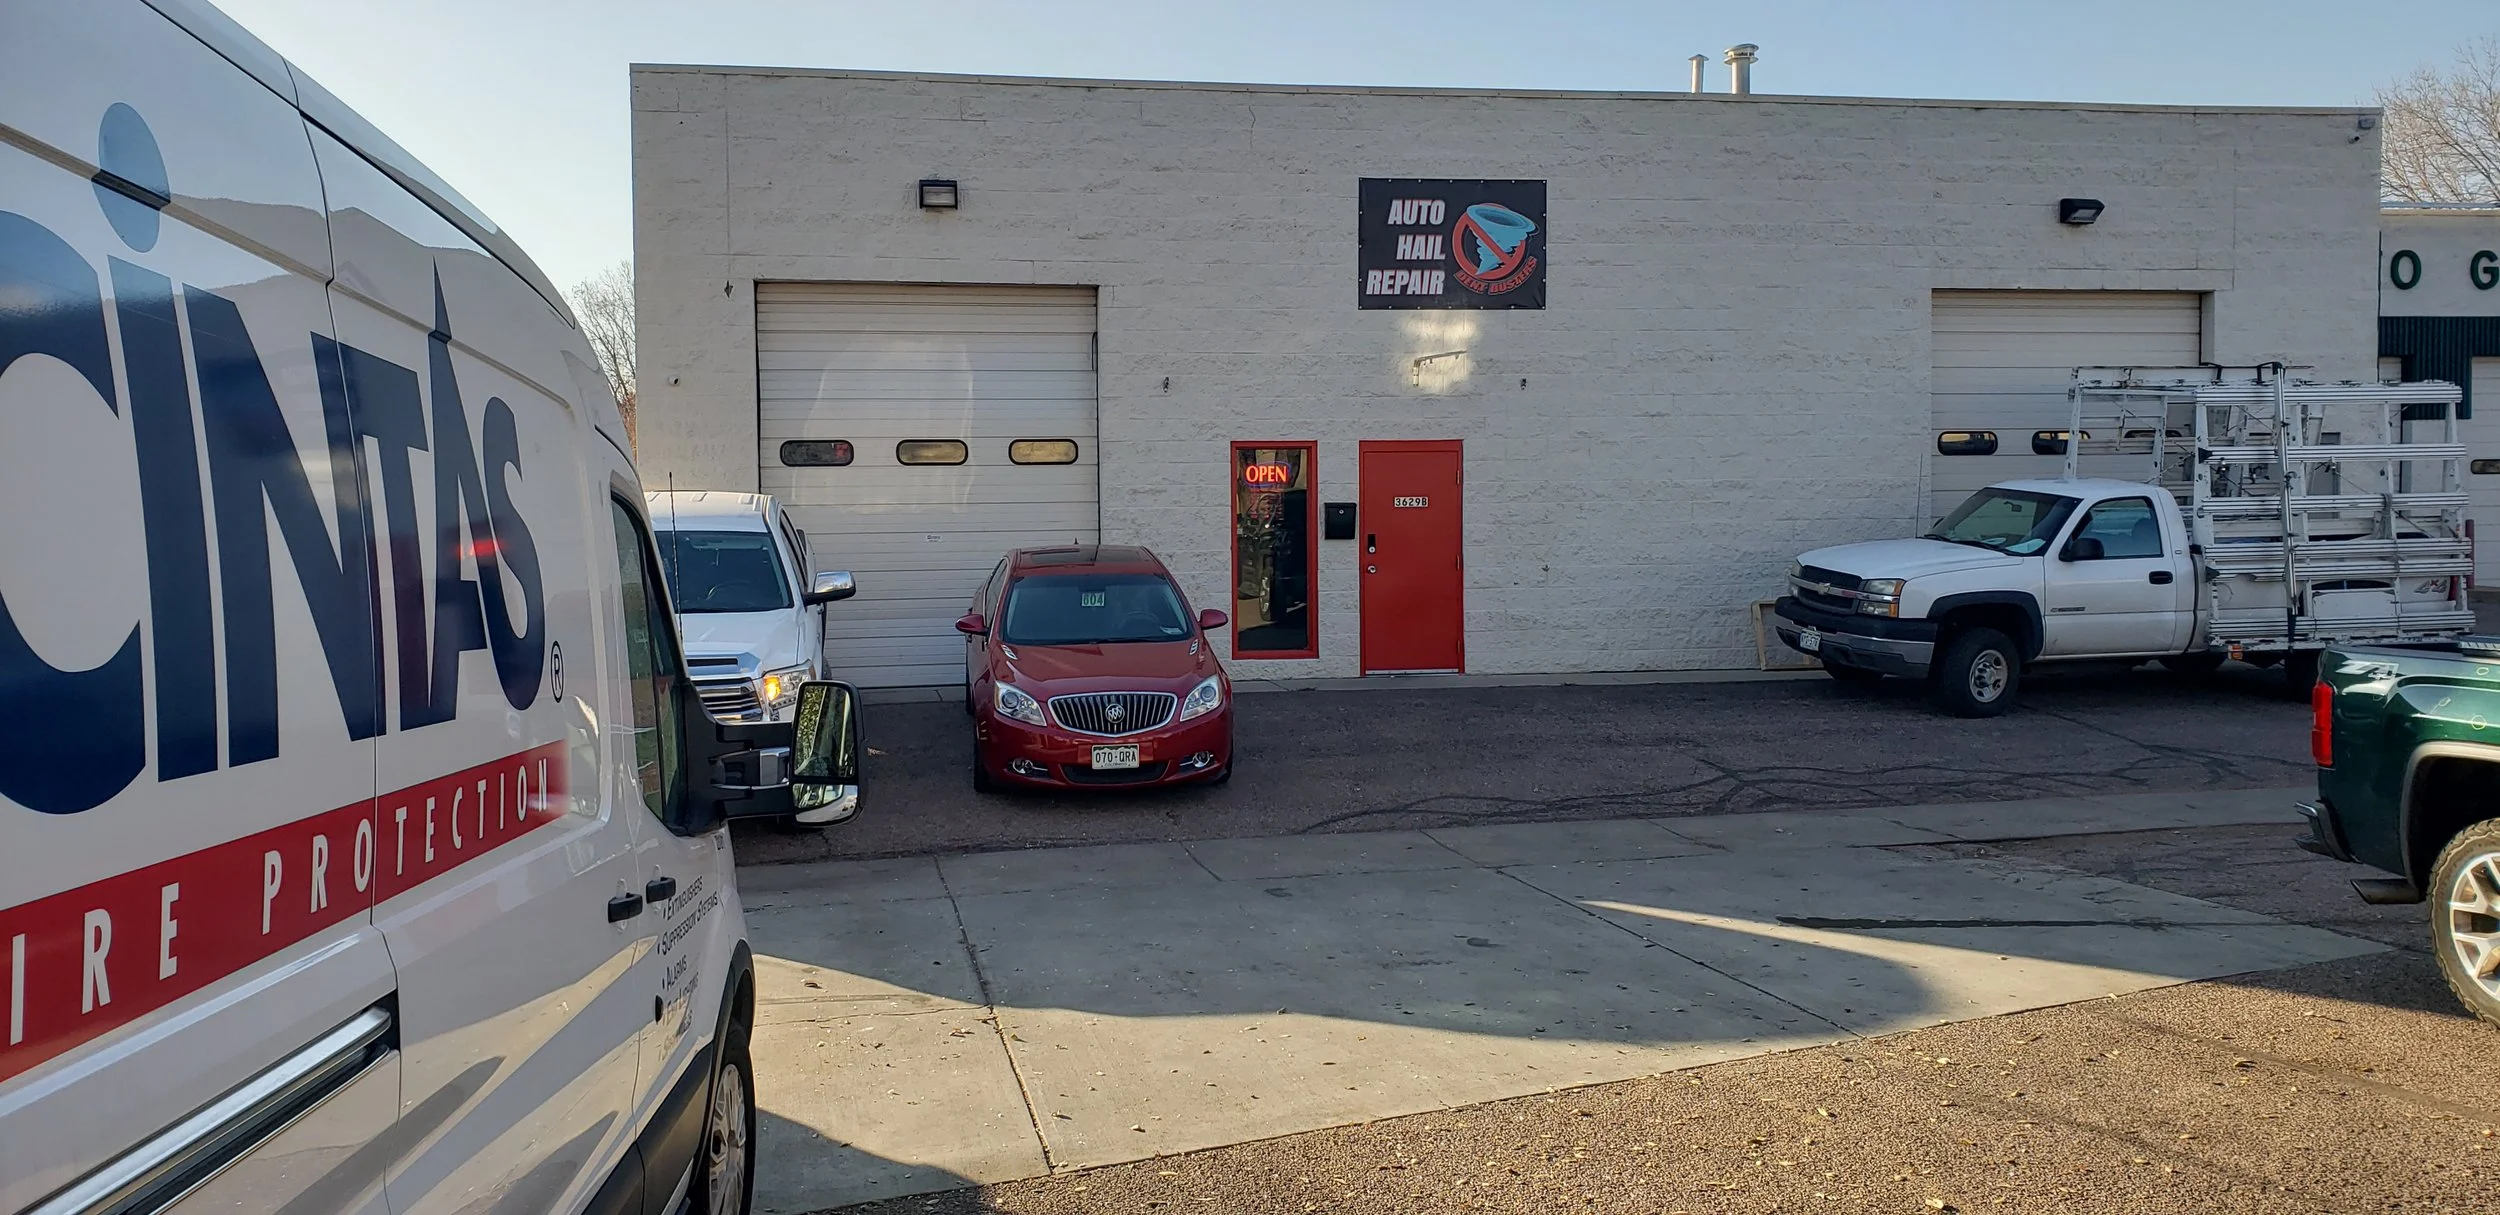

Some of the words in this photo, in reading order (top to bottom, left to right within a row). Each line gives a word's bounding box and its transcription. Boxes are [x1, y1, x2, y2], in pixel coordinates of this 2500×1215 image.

[1388, 199, 1445, 225] AUTO
[1396, 234, 1445, 260] HAIL
[1366, 269, 1445, 295] REPAIR
[1455, 270, 1489, 294] DENT
[1488, 256, 1538, 295] BUSTERS
[1245, 464, 1288, 483] OPEN
[1395, 497, 1428, 507] 3629B
[260, 757, 548, 936] PROTECTION
